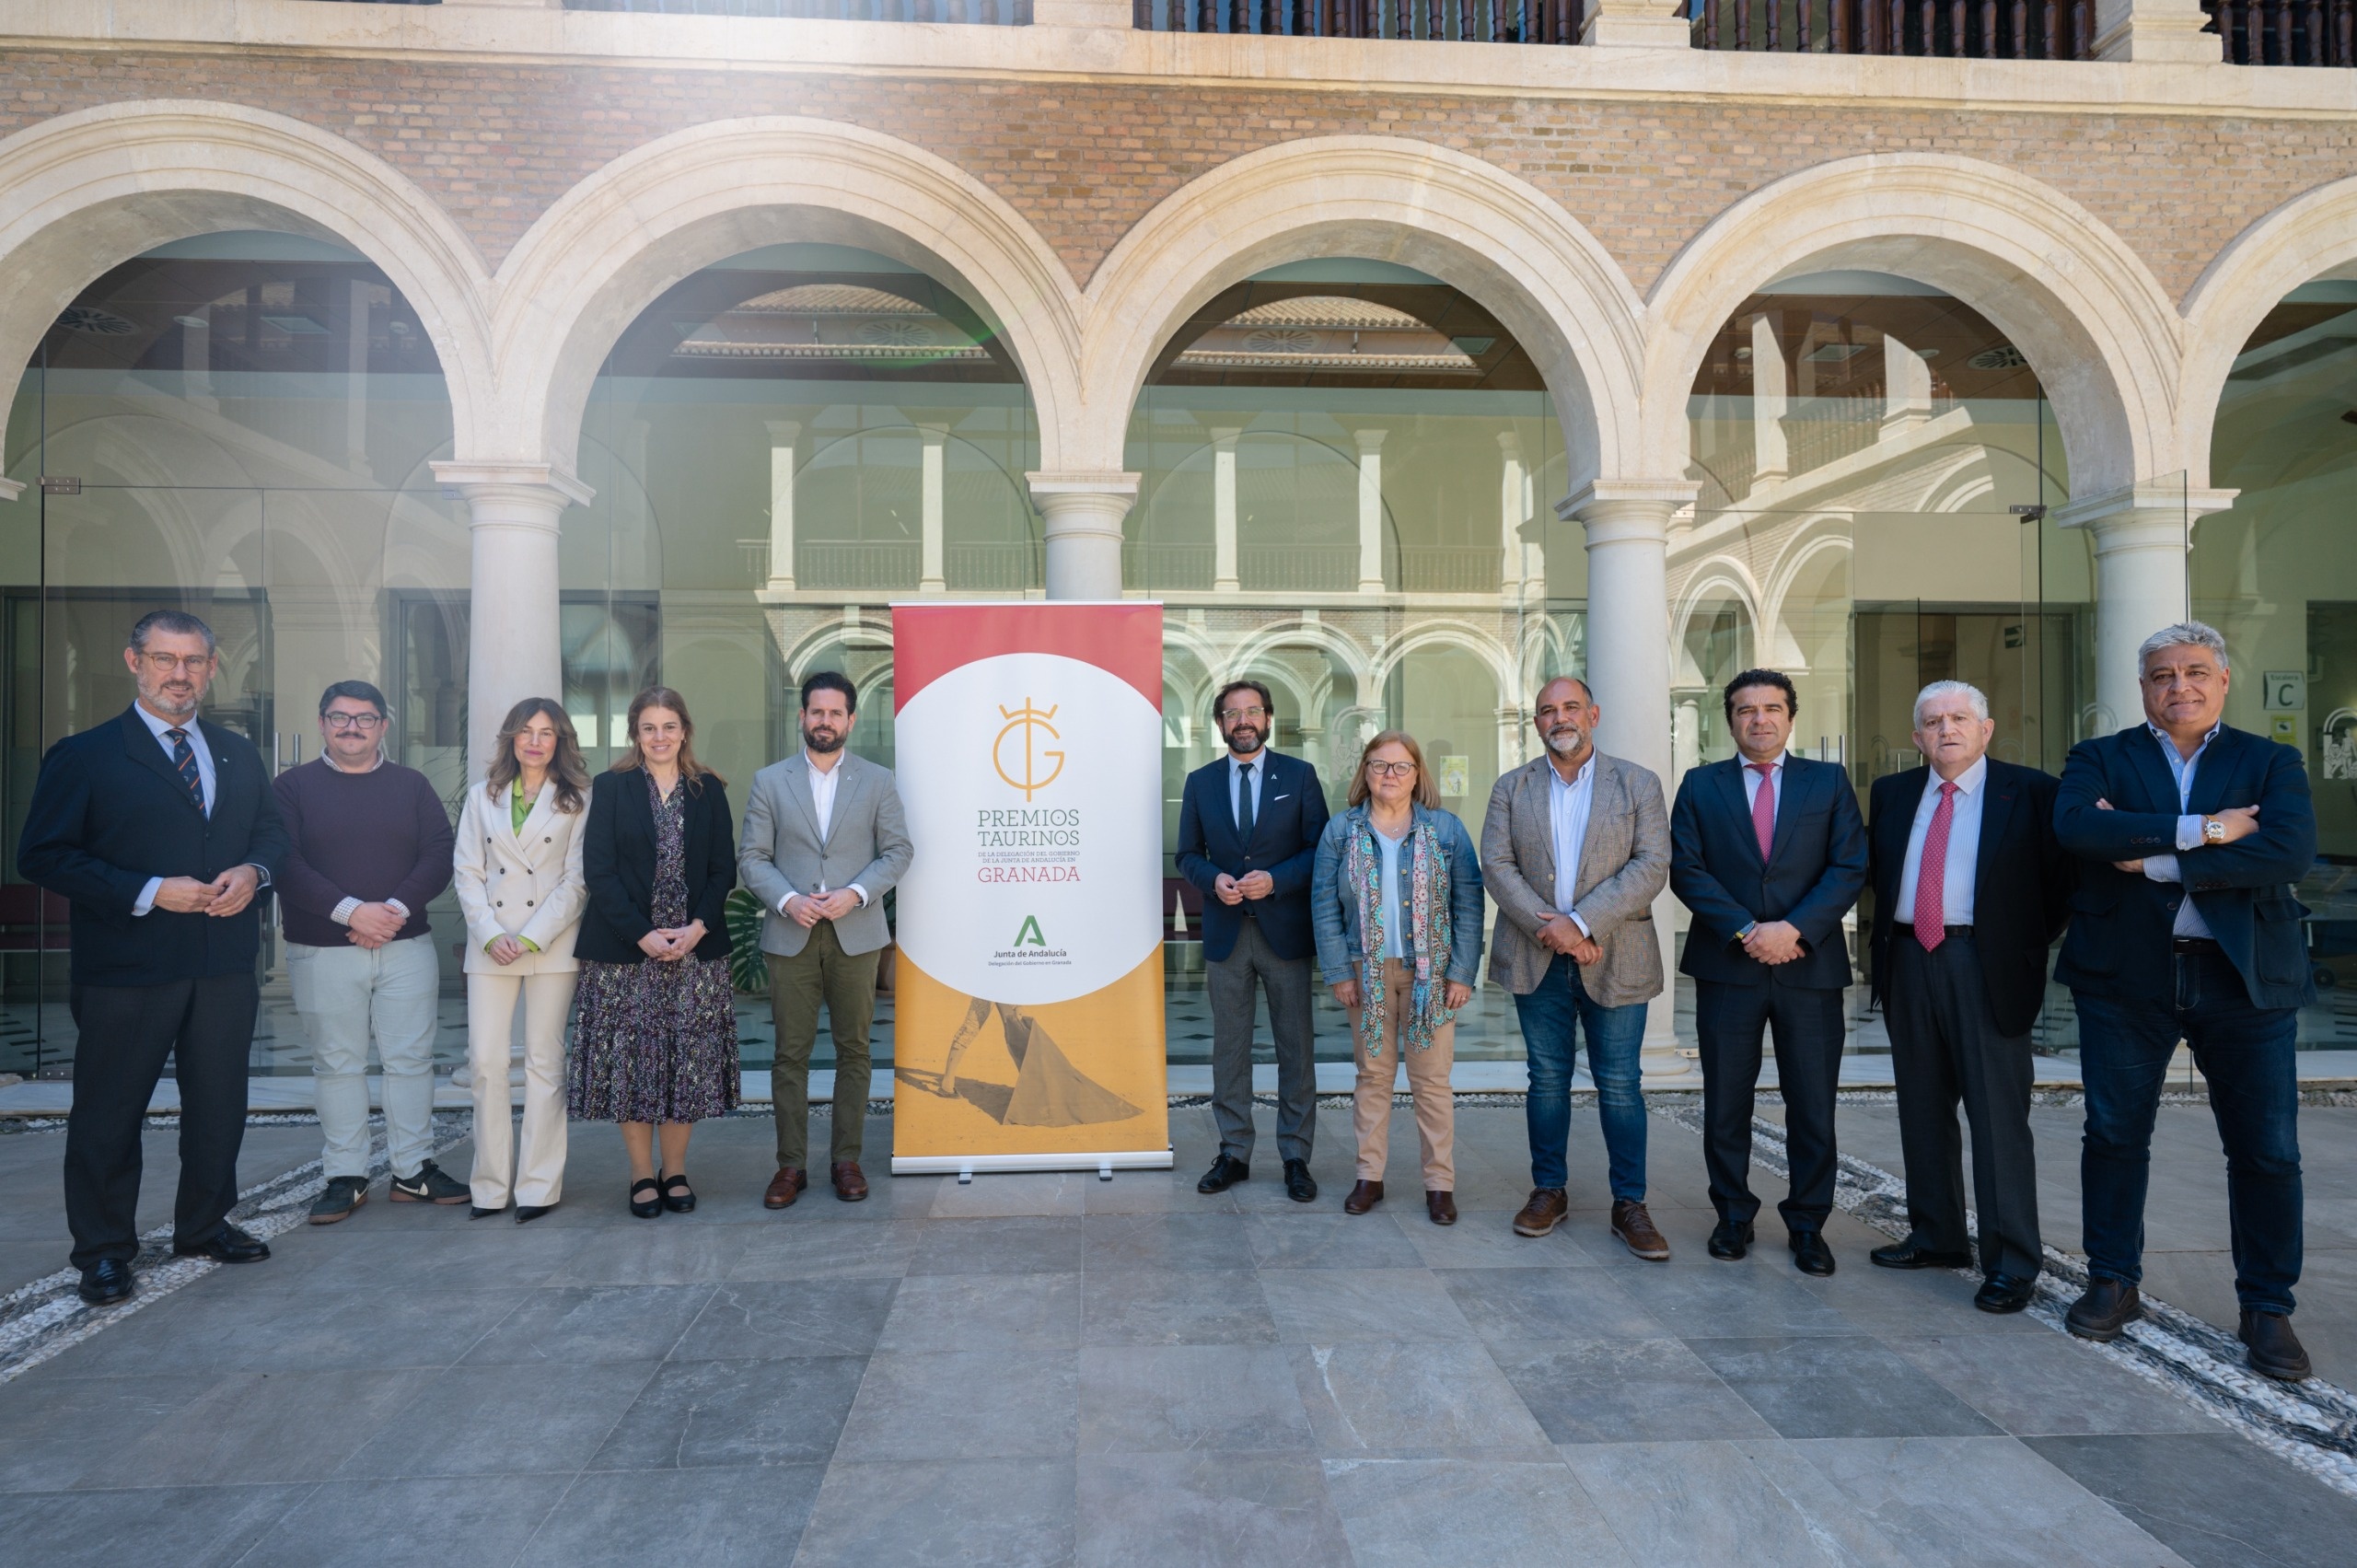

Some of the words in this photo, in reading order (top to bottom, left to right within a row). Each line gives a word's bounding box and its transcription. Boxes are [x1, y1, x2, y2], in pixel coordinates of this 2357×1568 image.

[2279, 683, 2293, 706] C
[978, 809, 1079, 827] PREMIOS
[978, 830, 1079, 846] TAURINOS
[978, 866, 1081, 882] GRANADA
[1028, 948, 1066, 957] Andalucía
